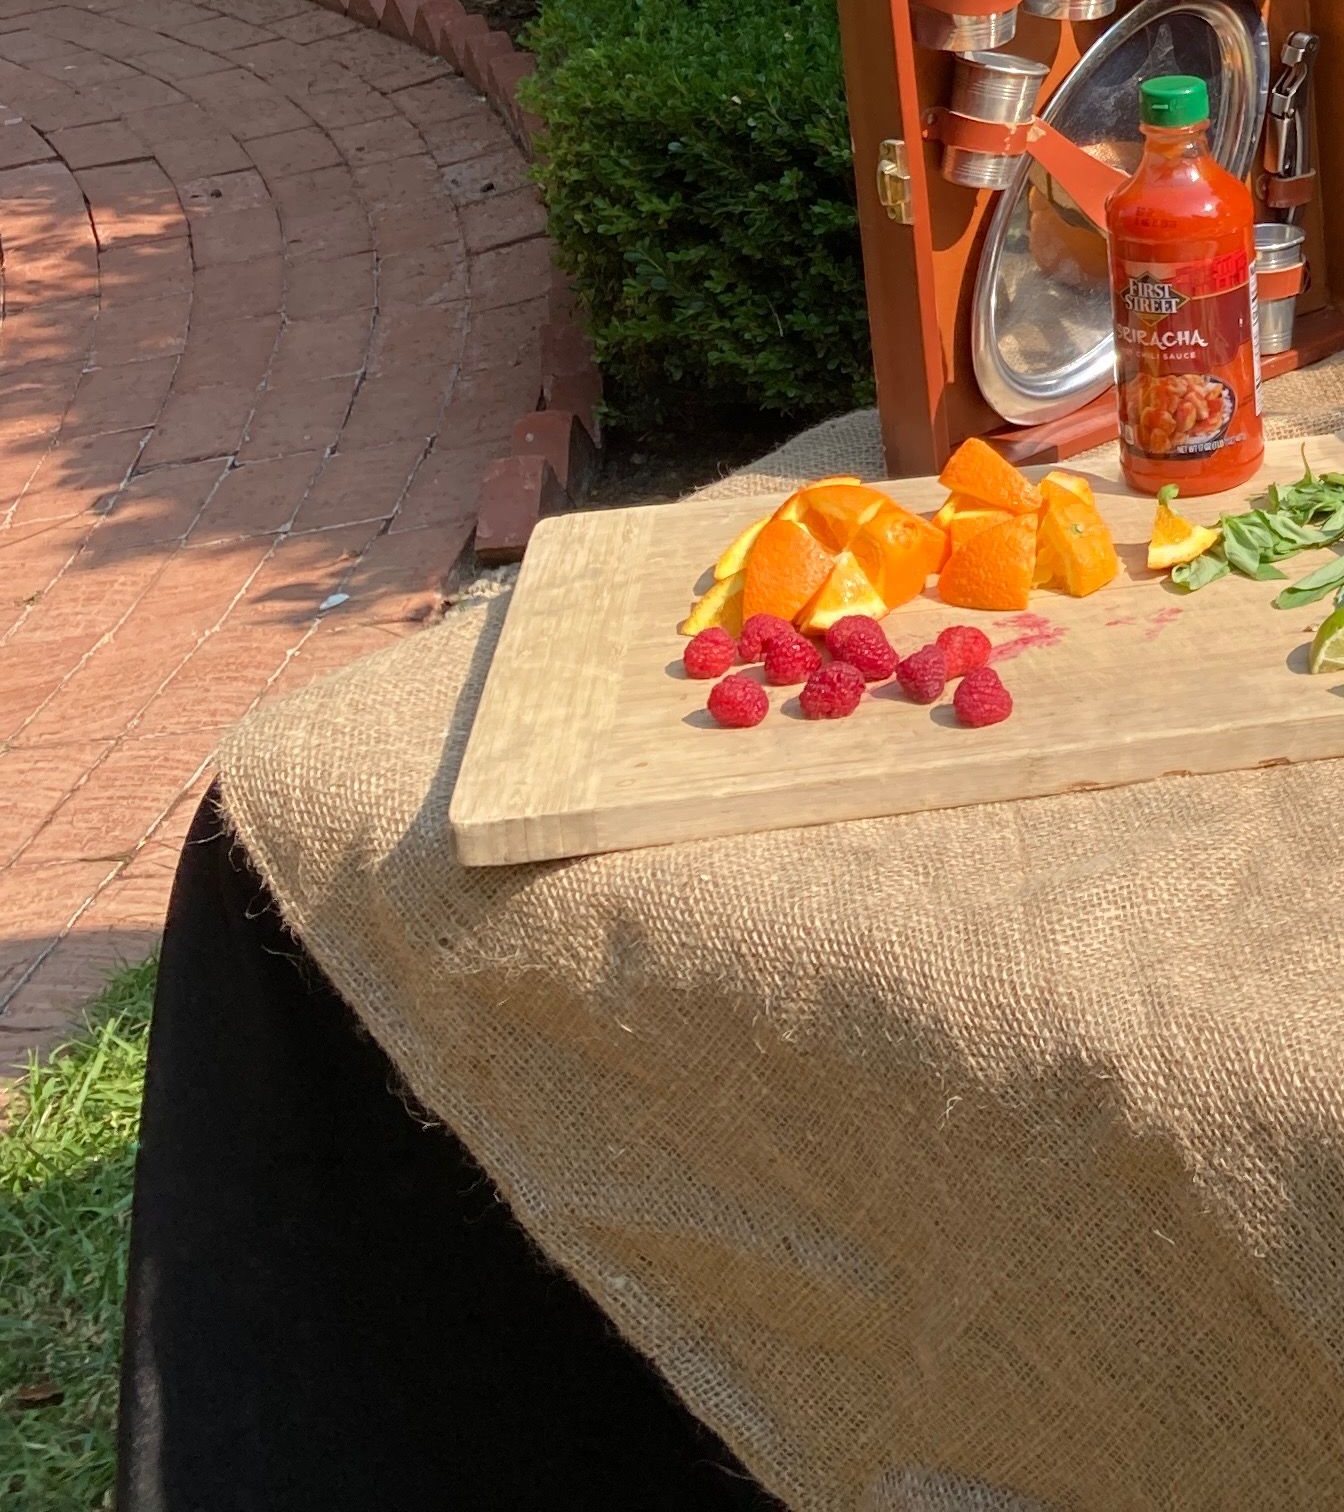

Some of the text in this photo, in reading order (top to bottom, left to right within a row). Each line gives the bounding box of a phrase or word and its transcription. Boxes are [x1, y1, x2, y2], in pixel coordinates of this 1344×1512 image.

[1128, 278, 1173, 299] FIRST
[1124, 294, 1180, 314] STREET
[1117, 324, 1209, 351] SRIRACHA
[1163, 351, 1197, 361] SAUCE
